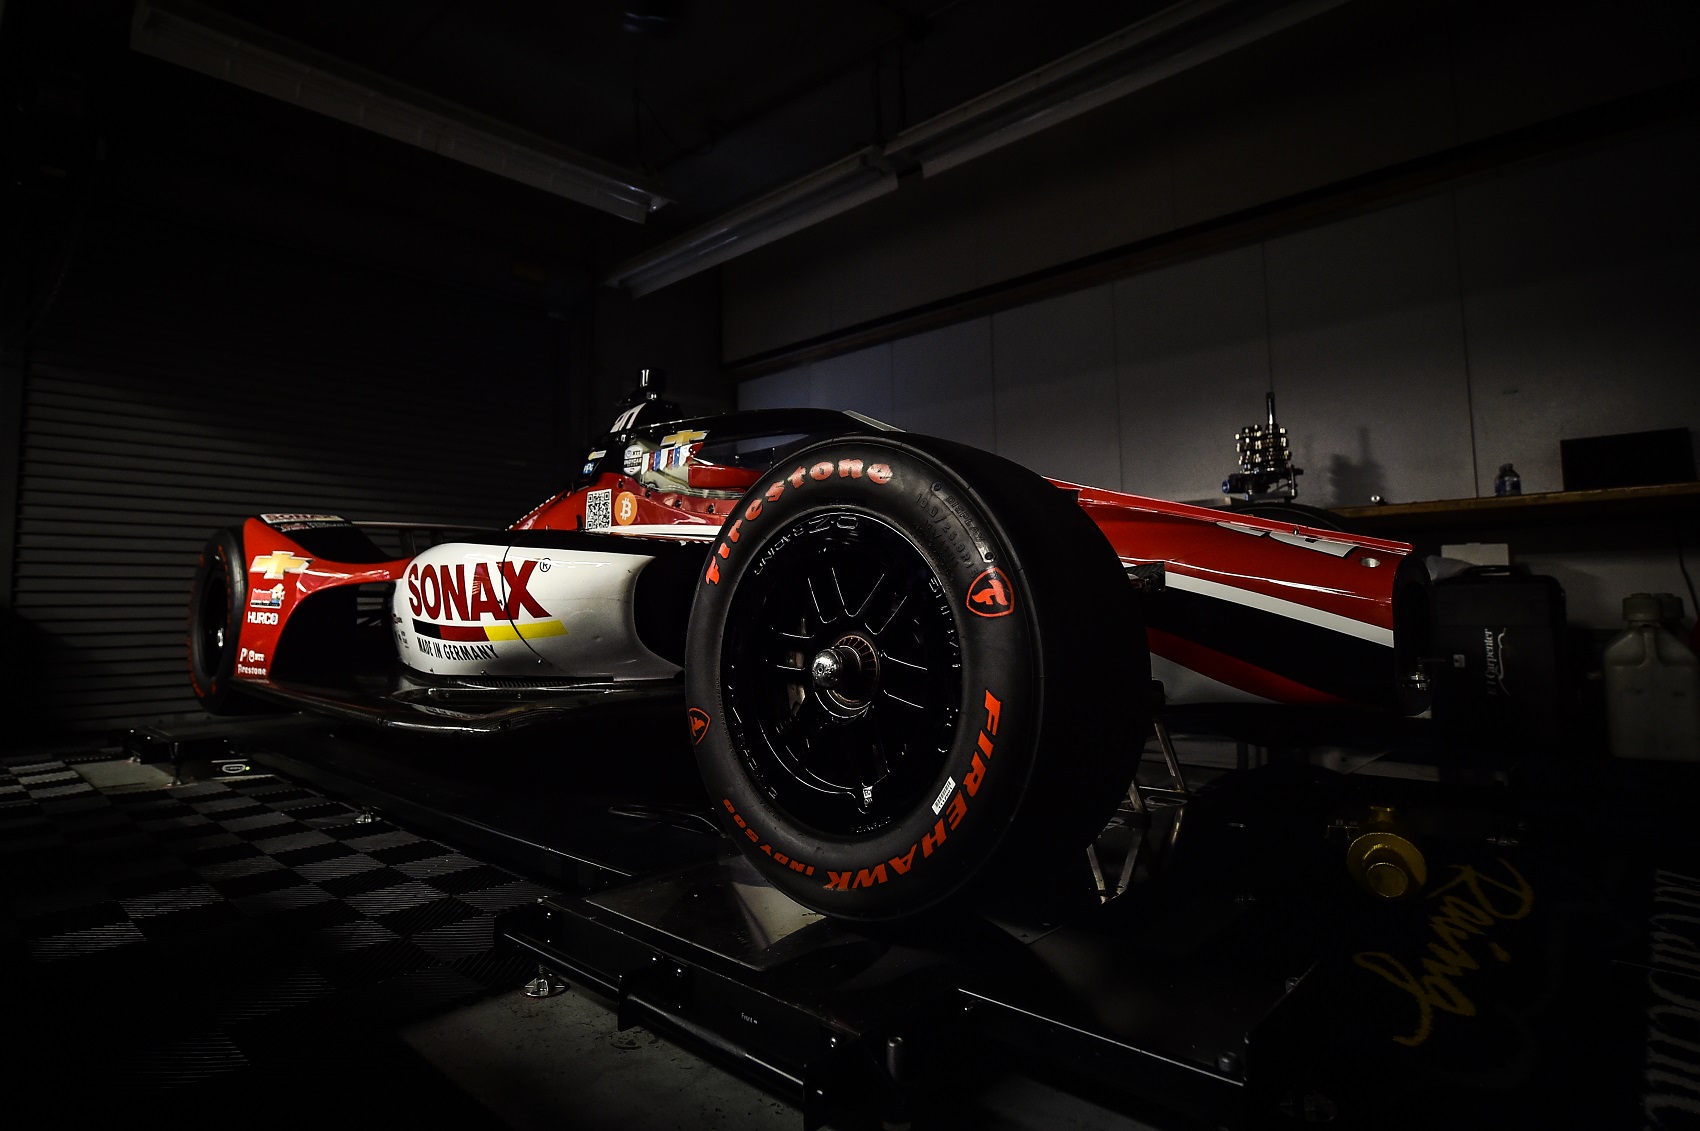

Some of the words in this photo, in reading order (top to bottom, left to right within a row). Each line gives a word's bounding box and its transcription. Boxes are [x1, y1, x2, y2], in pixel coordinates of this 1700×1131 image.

[705, 458, 893, 586] Firestone
[408, 560, 552, 622] SONAX
[247, 611, 279, 626] HURCO
[237, 663, 267, 676] Firestone
[416, 637, 434, 657] MADE
[434, 640, 443, 659] IN
[444, 644, 499, 661] GERMANY
[823, 689, 1002, 891] FIREHAWK
